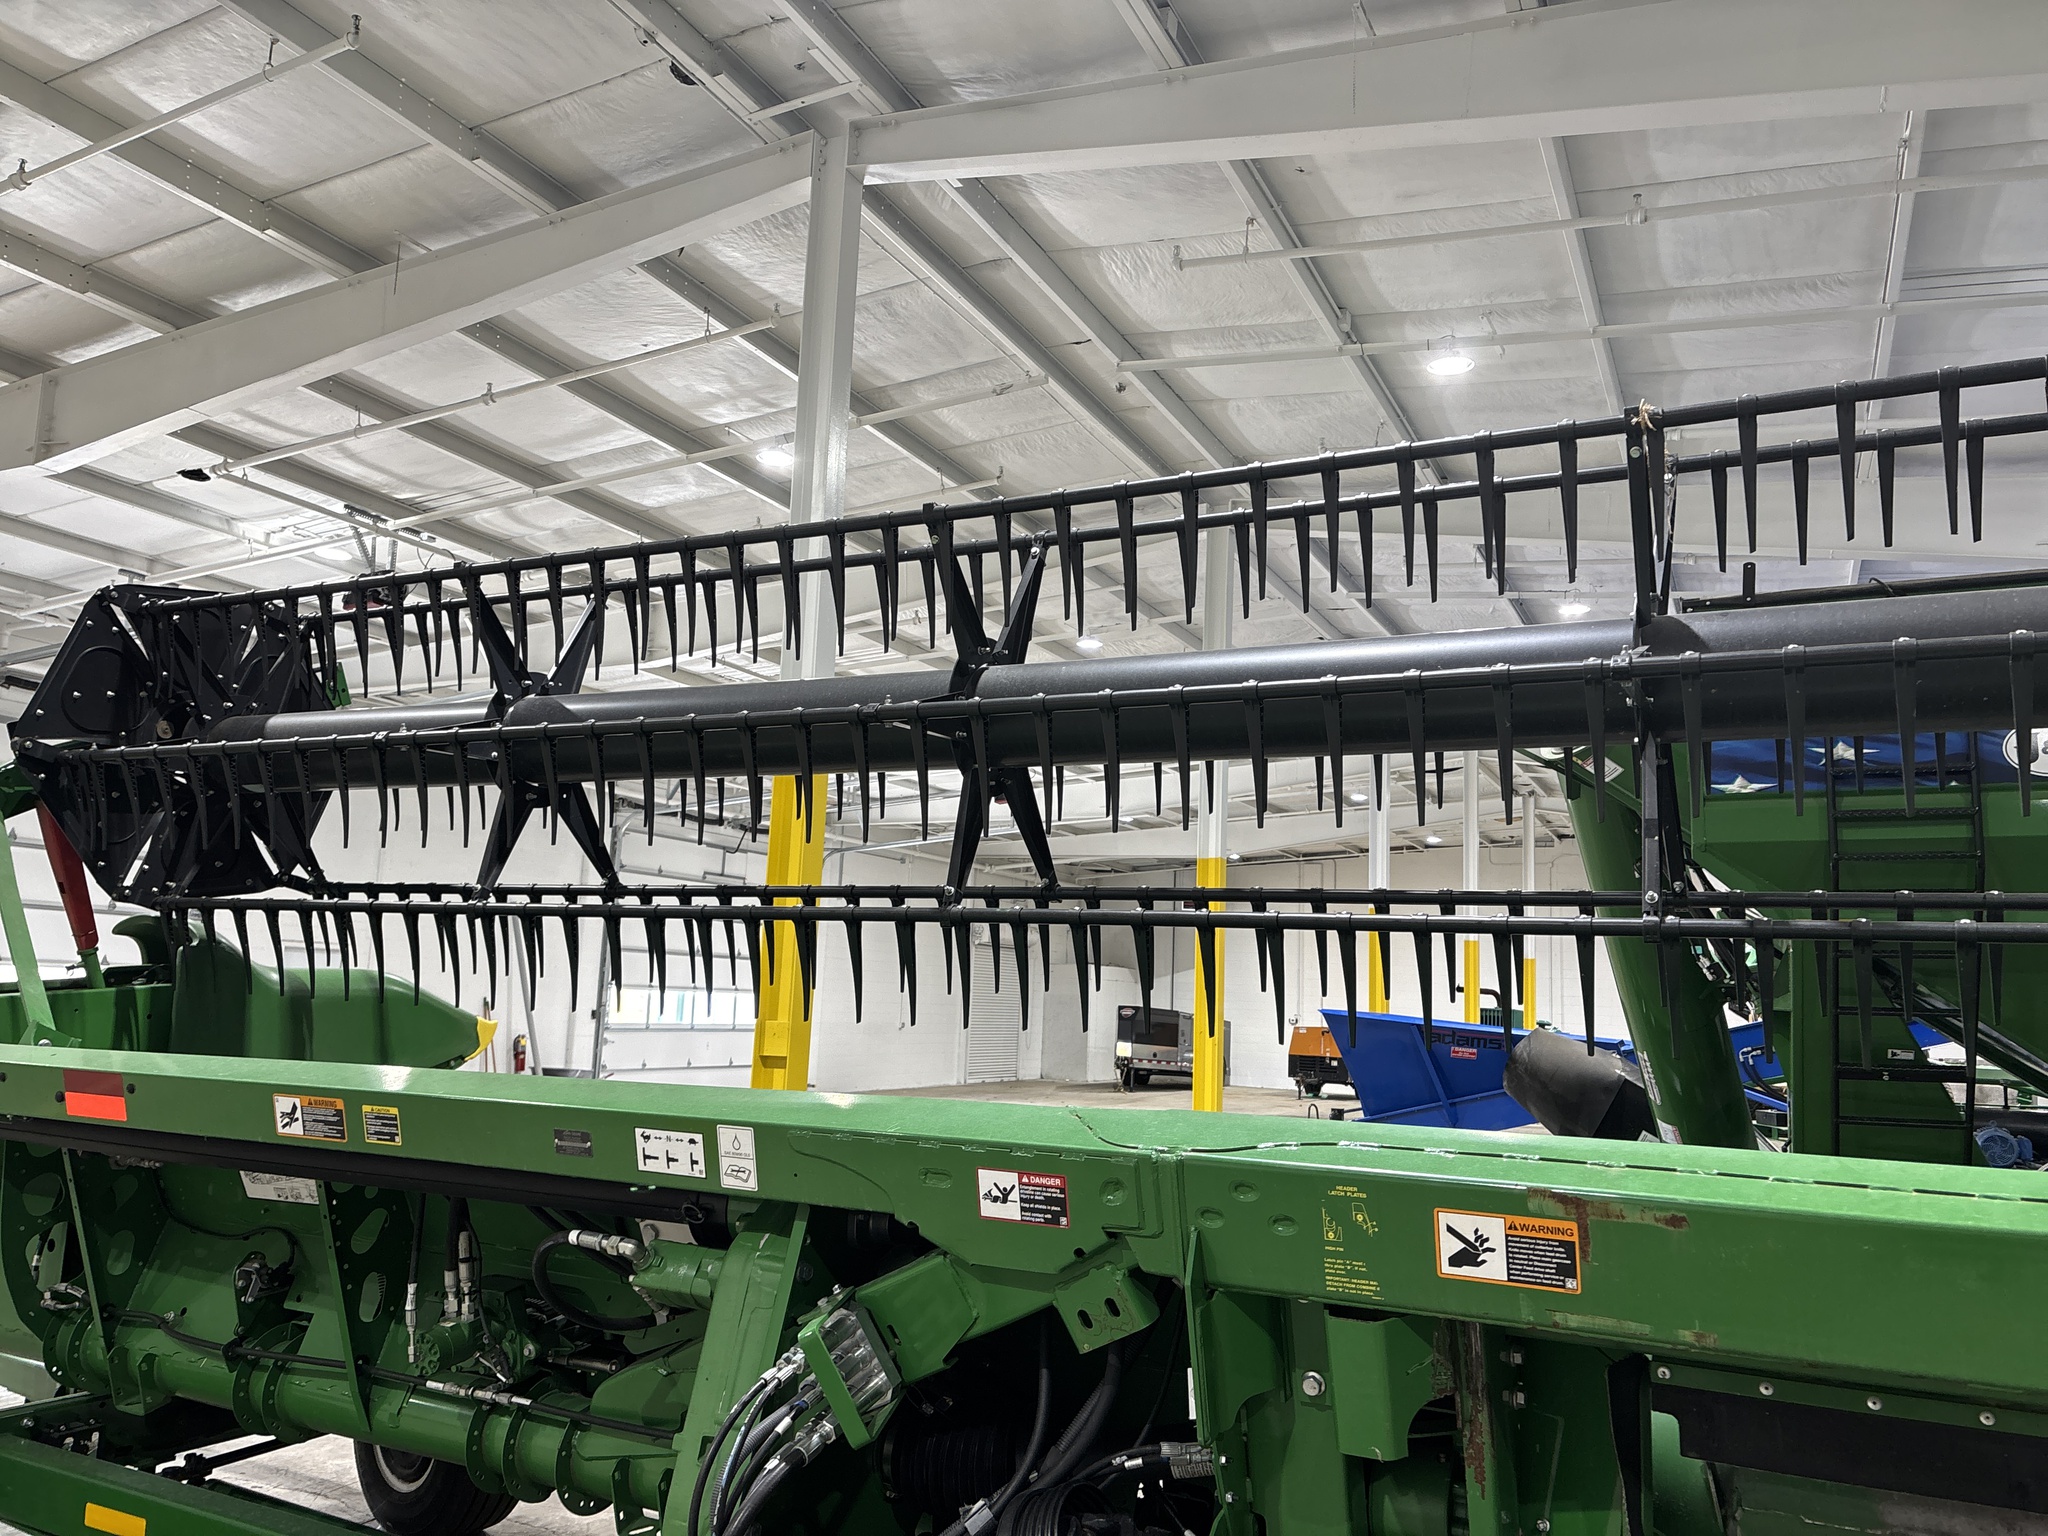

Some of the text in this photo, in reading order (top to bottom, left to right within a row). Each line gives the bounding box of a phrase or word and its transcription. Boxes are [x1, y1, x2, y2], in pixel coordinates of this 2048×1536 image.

[313, 1099, 337, 1108] WARNING
[1030, 1176, 1060, 1185] DANGER
[1519, 1223, 1574, 1237] WARNING
